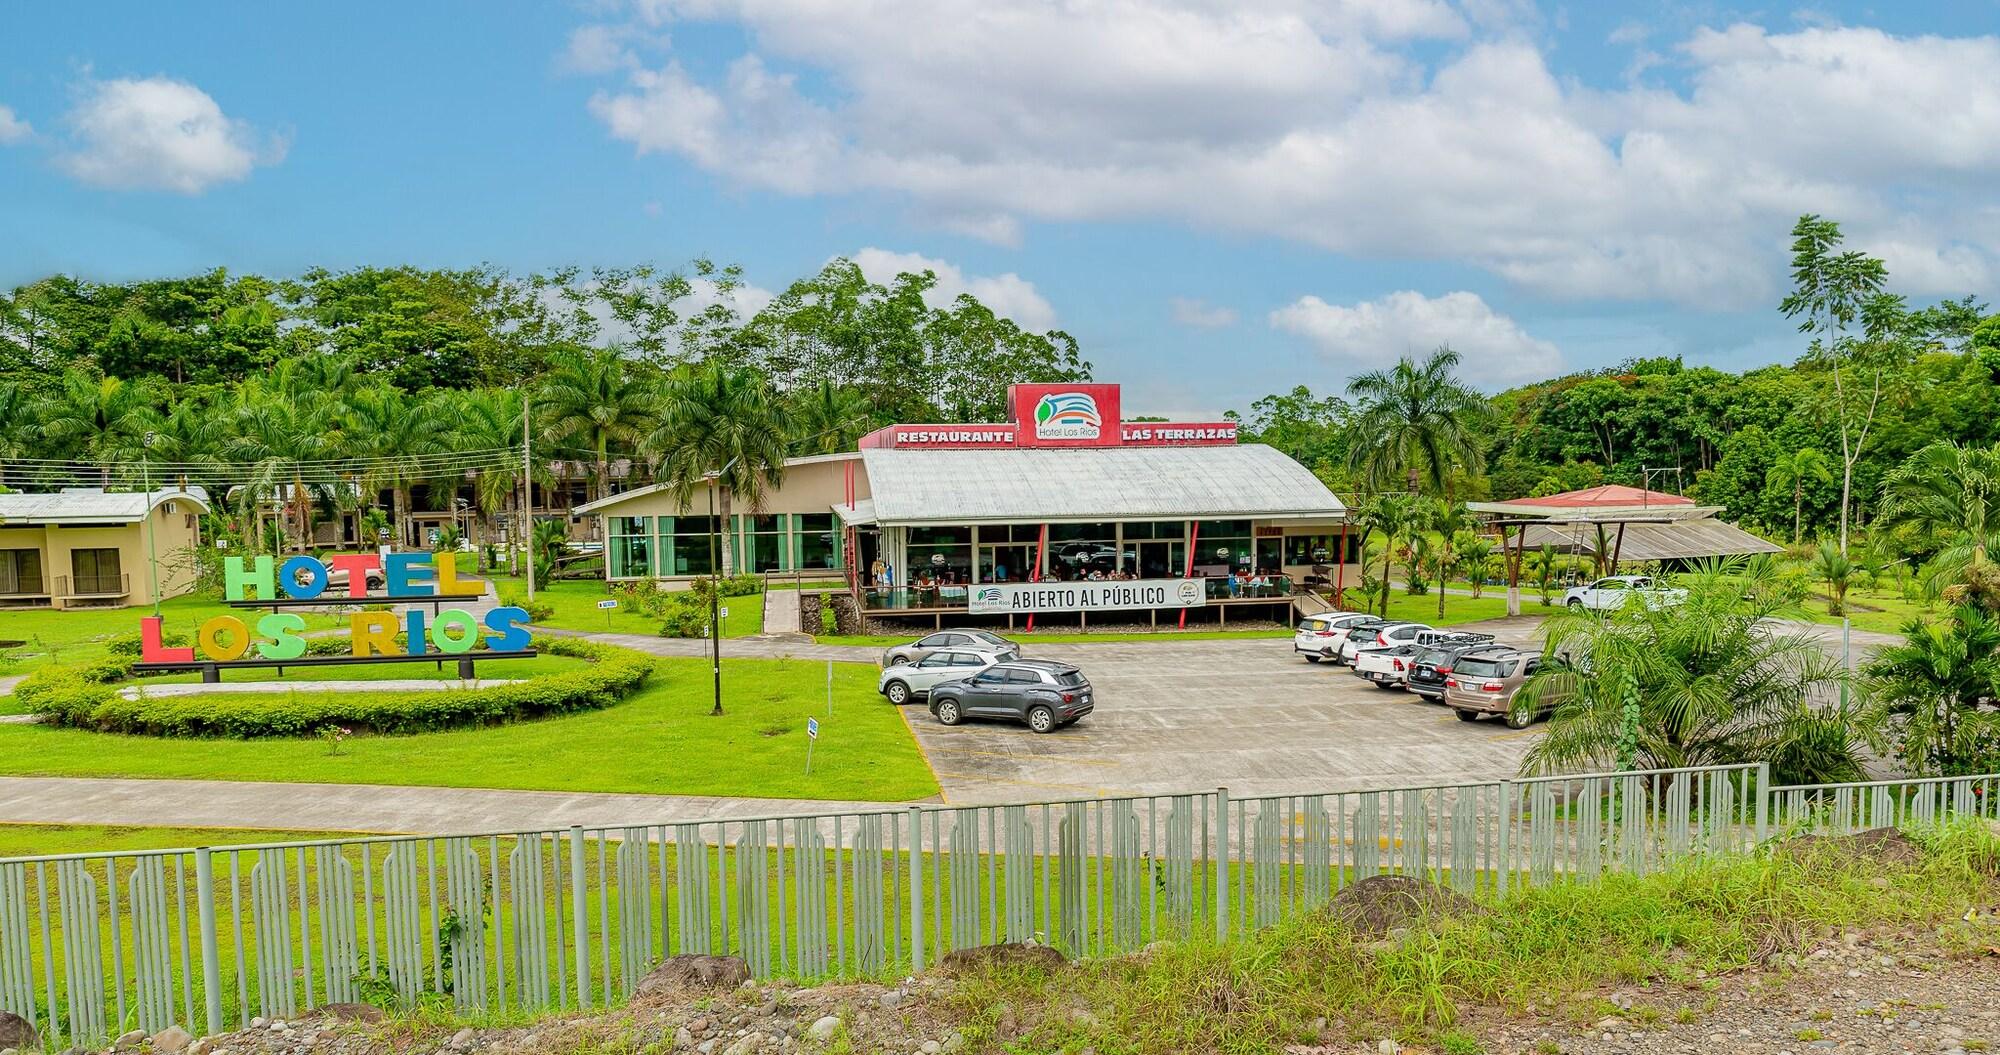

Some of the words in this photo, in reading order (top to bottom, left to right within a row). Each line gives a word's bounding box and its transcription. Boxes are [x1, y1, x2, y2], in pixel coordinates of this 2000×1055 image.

[897, 431, 1014, 443] RESTAURANTE
[1039, 428, 1062, 436] Hotel
[1064, 428, 1078, 436] Los
[1122, 430, 1152, 441] LAS
[1156, 428, 1236, 440] TERRAZAS
[224, 552, 486, 600] HOTEL
[1012, 590, 1075, 609] ABIERTO
[1080, 589, 1098, 606] AL
[1103, 585, 1165, 606] PÚBLICO
[141, 614, 309, 663] LOS
[351, 607, 532, 657] RIOS
